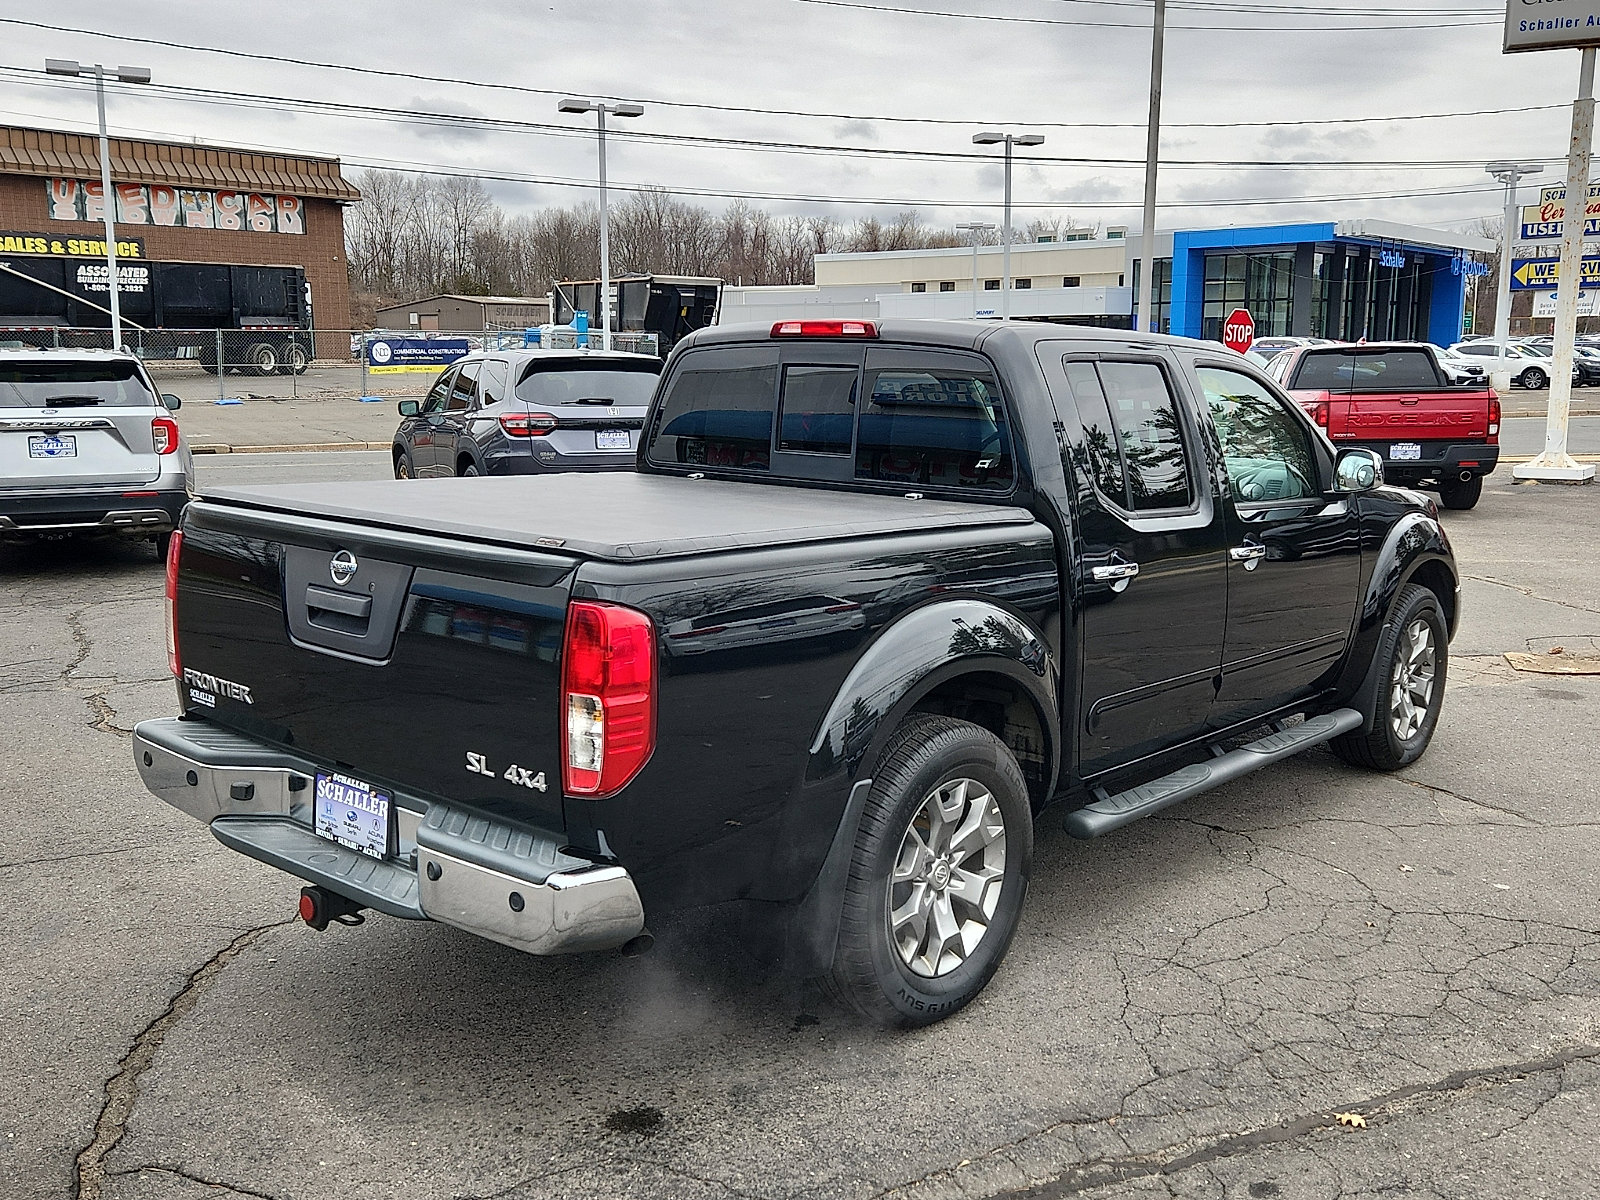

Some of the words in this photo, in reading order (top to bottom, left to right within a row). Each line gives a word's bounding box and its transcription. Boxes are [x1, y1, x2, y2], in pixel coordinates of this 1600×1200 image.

[1520, 17, 1579, 31] Schaller
[52, 178, 175, 208] USED
[215, 190, 299, 216] CAR
[51, 241, 65, 254] &
[67, 240, 140, 257] SERVICE
[1379, 250, 1406, 268] Schaller
[77, 265, 149, 278] ASSOIATED
[1461, 261, 1489, 276] HONDA
[1535, 264, 1555, 277] WE
[1226, 324, 1252, 343] STOP
[1345, 414, 1474, 426] RIDGELINE
[31, 442, 74, 450] SCHALLER
[183, 667, 254, 705] FRONTIER
[189, 688, 216, 704] SCHALLER
[465, 751, 496, 778] SL
[332, 773, 370, 792] SCHALLER
[317, 779, 389, 821] SCHALLER
